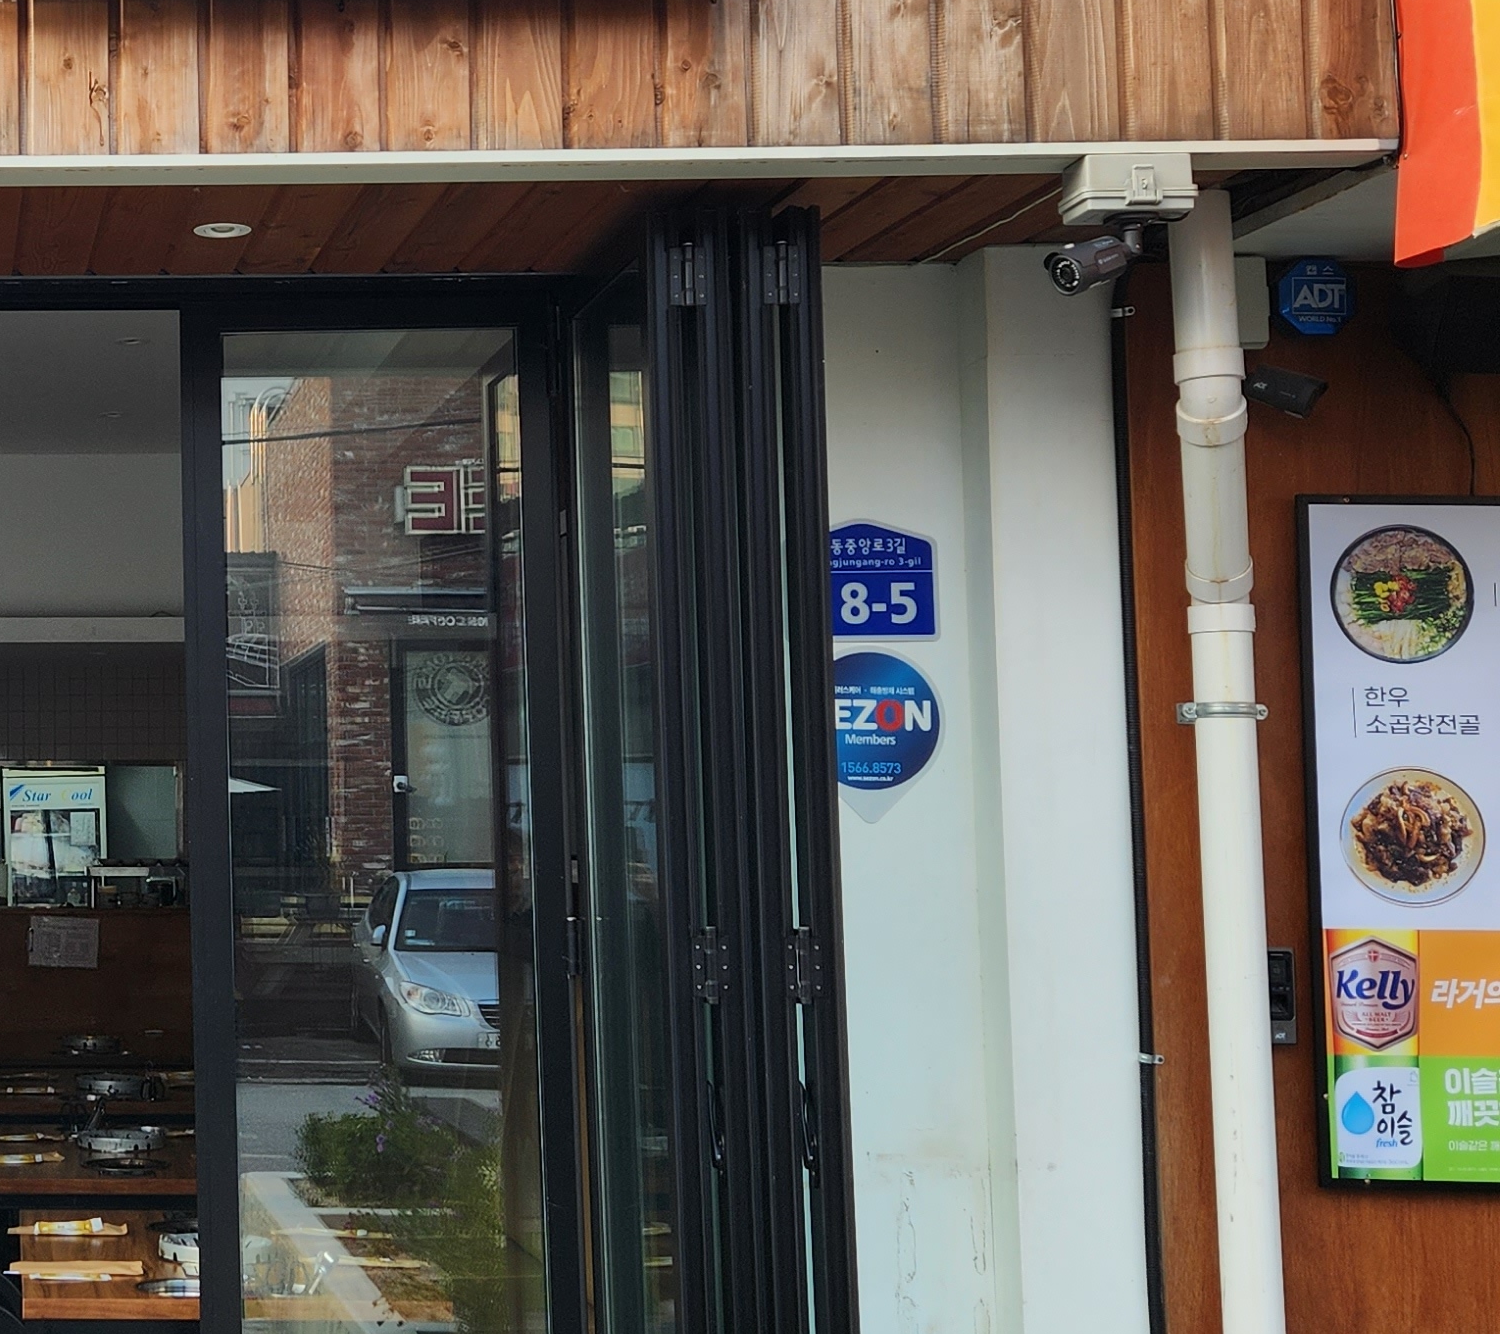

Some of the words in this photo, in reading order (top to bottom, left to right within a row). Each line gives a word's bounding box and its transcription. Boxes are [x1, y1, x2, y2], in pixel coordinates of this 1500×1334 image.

[1293, 283, 1347, 309] ADT
[830, 537, 906, 555] 동중앙로3길
[898, 556, 922, 568] 3-gil
[840, 582, 918, 625] 8-5
[1364, 686, 1410, 708] 한우
[835, 698, 931, 732] EZON
[1366, 714, 1480, 735] 소곱창전골
[845, 733, 897, 745] Members
[841, 762, 902, 774] 1566.8573
[22, 788, 51, 803] Star
[61, 787, 94, 802] Cool
[1336, 969, 1415, 1010] Kelly
[1444, 1067, 1500, 1095] 이슬
[1372, 1080, 1402, 1115] 참
[1448, 1100, 1500, 1127] 깨끗
[1377, 1110, 1413, 1146] 이슬
[1376, 1137, 1398, 1148] fresh
